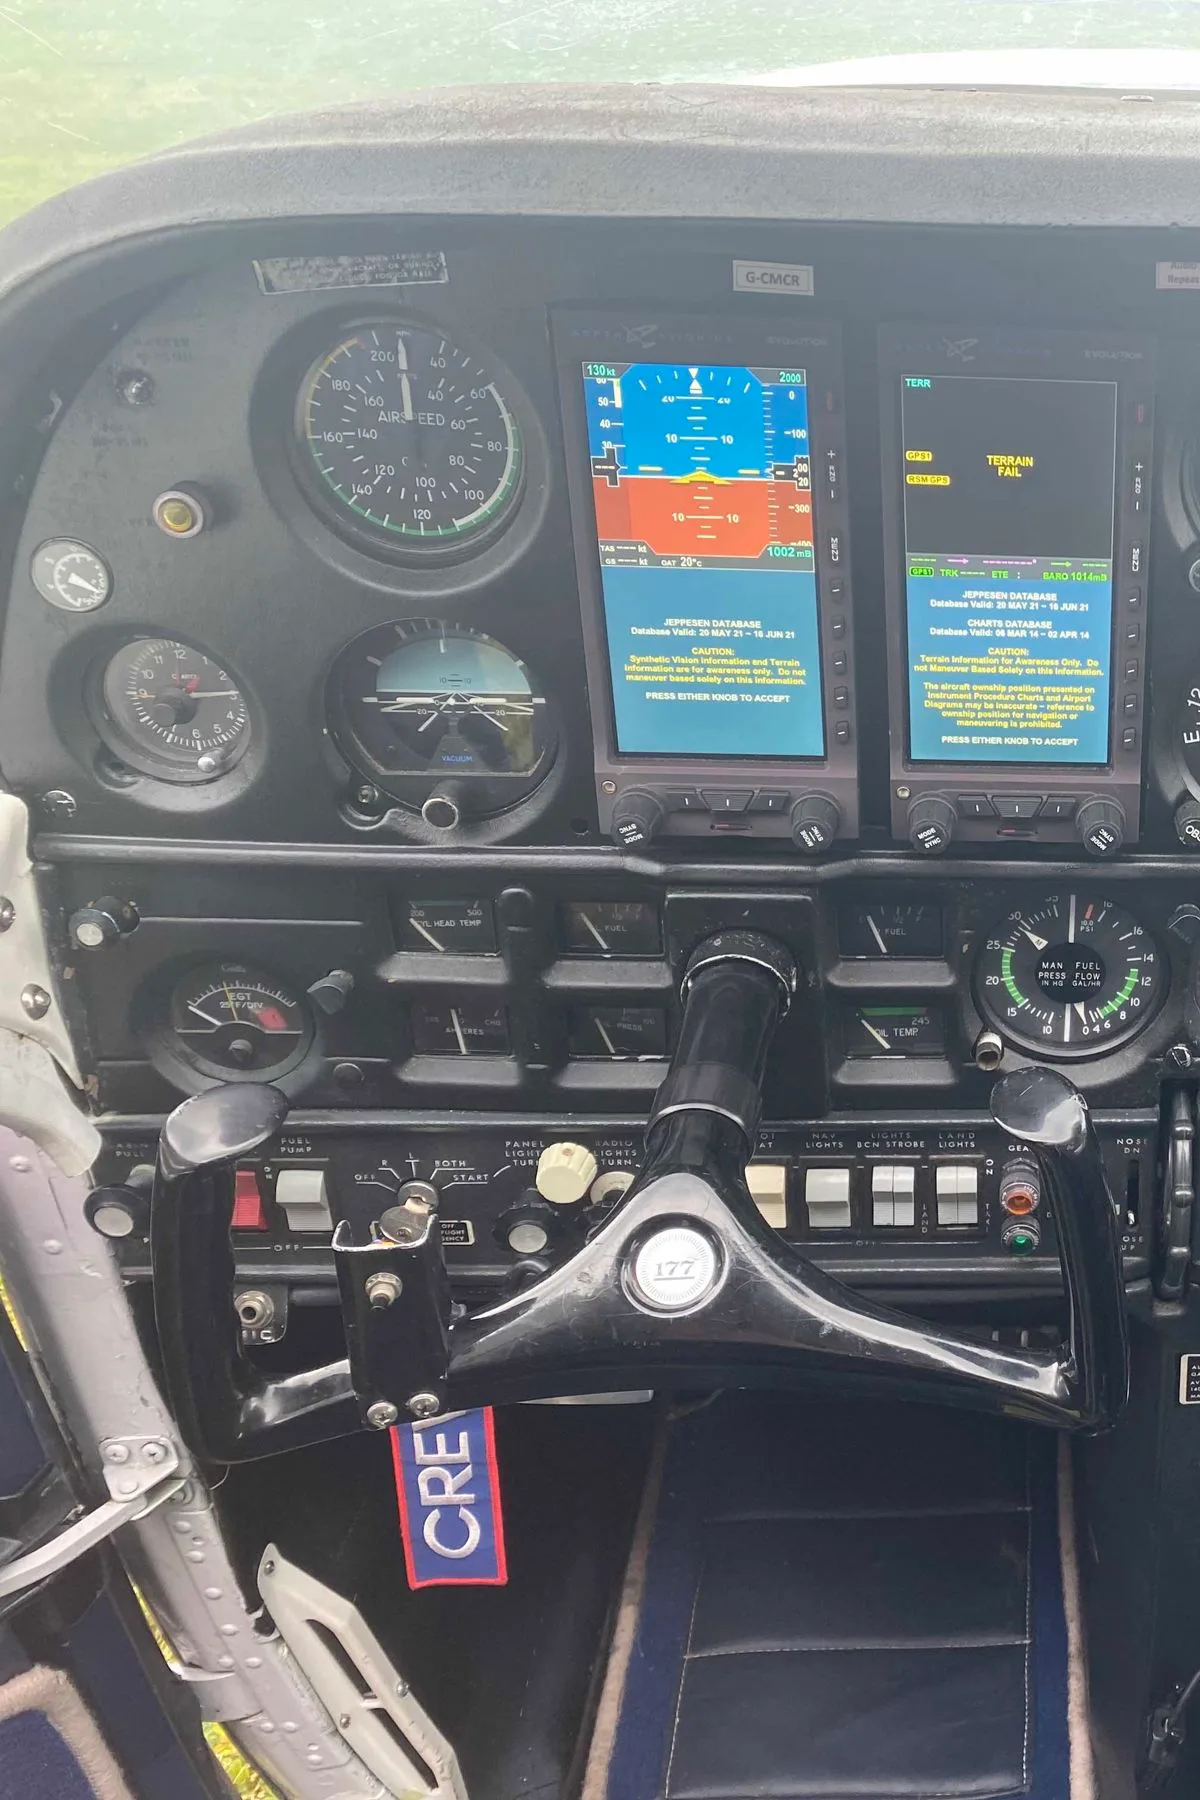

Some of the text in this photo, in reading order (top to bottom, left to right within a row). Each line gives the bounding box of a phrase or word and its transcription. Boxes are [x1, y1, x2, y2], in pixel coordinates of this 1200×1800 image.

[745, 270, 801, 288] G-CMCR
[370, 350, 395, 363] 200
[430, 357, 446, 369] 40
[586, 364, 616, 377] 130 kt
[779, 372, 801, 383] 2000
[331, 380, 351, 392] 180
[905, 378, 931, 388] TERR
[470, 388, 486, 400] 60
[322, 431, 344, 443] 160
[357, 428, 378, 440] 140
[487, 441, 502, 452] 80
[907, 451, 931, 460] GPS1
[986, 454, 1034, 467] TERRAIN
[997, 466, 1022, 477] FAIL
[908, 475, 949, 484] RSM GPS
[351, 484, 373, 496] 140
[464, 489, 485, 501] 100
[413, 509, 432, 520] 120
[767, 547, 795, 558] 1002
[1042, 571, 1069, 581] BARO
[663, 618, 762, 629] JEPPESEN DATABASE
[691, 647, 735, 656] CAUTION:
[920, 655, 1099, 668] Terrain Information for Awareness Only. Do
[645, 691, 791, 703] PRESS EITHER KNOB TO ACCEPT
[1133, 926, 1144, 936] 16
[986, 940, 1001, 950] 25
[1142, 954, 1154, 962] 14
[1041, 962, 1064, 970] MAN
[1075, 962, 1101, 970] FUEL
[985, 976, 1000, 985] 20
[1038, 972, 1067, 980] PRESS
[1075, 972, 1101, 981] FLOW
[1140, 977, 1152, 986] 12
[1007, 1007, 1018, 1017] 15
[280, 1137, 311, 1145] FUEL
[504, 1140, 545, 1148] PANEL
[806, 1141, 844, 1149] LIGHTS
[857, 1141, 926, 1149] BCN STROBE
[938, 1141, 976, 1149] LIGHTS
[434, 1159, 467, 1168] BOTH
[452, 1173, 489, 1182] START
[653, 1260, 696, 1276] 177
[411, 1411, 481, 1559] CRE
